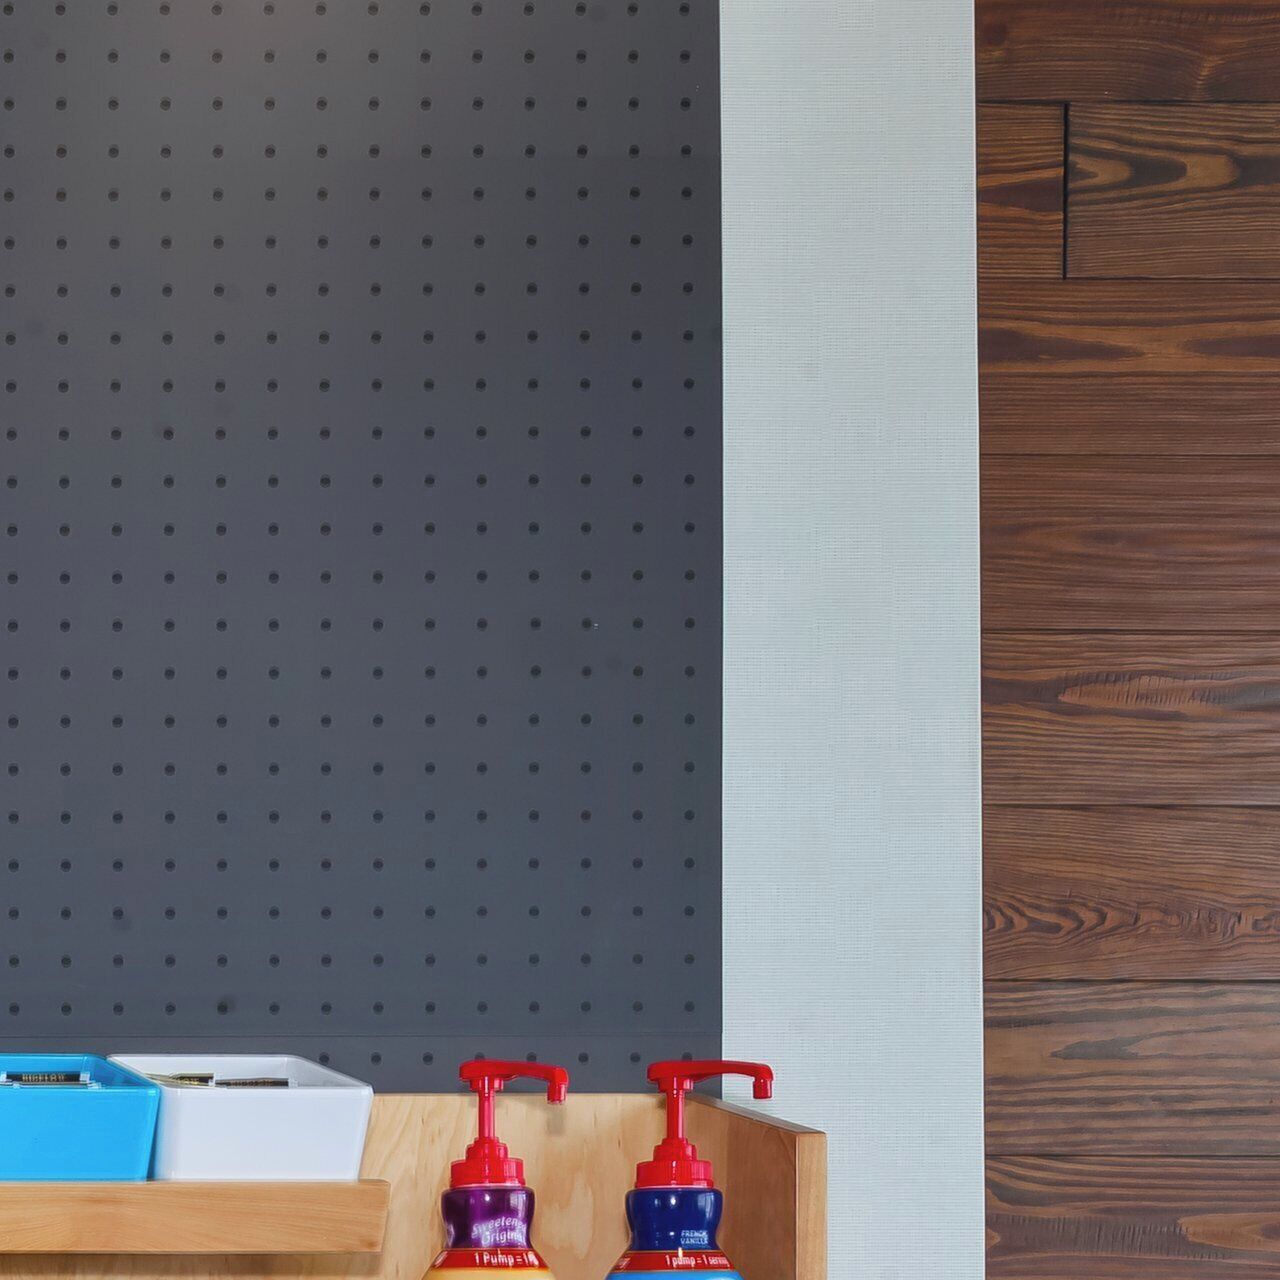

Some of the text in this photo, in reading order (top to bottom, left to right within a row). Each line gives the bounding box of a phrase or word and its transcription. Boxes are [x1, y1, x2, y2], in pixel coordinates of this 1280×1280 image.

[483, 1252, 515, 1268] Pump
[665, 1255, 671, 1266] 1
[672, 1256, 696, 1269] pump
